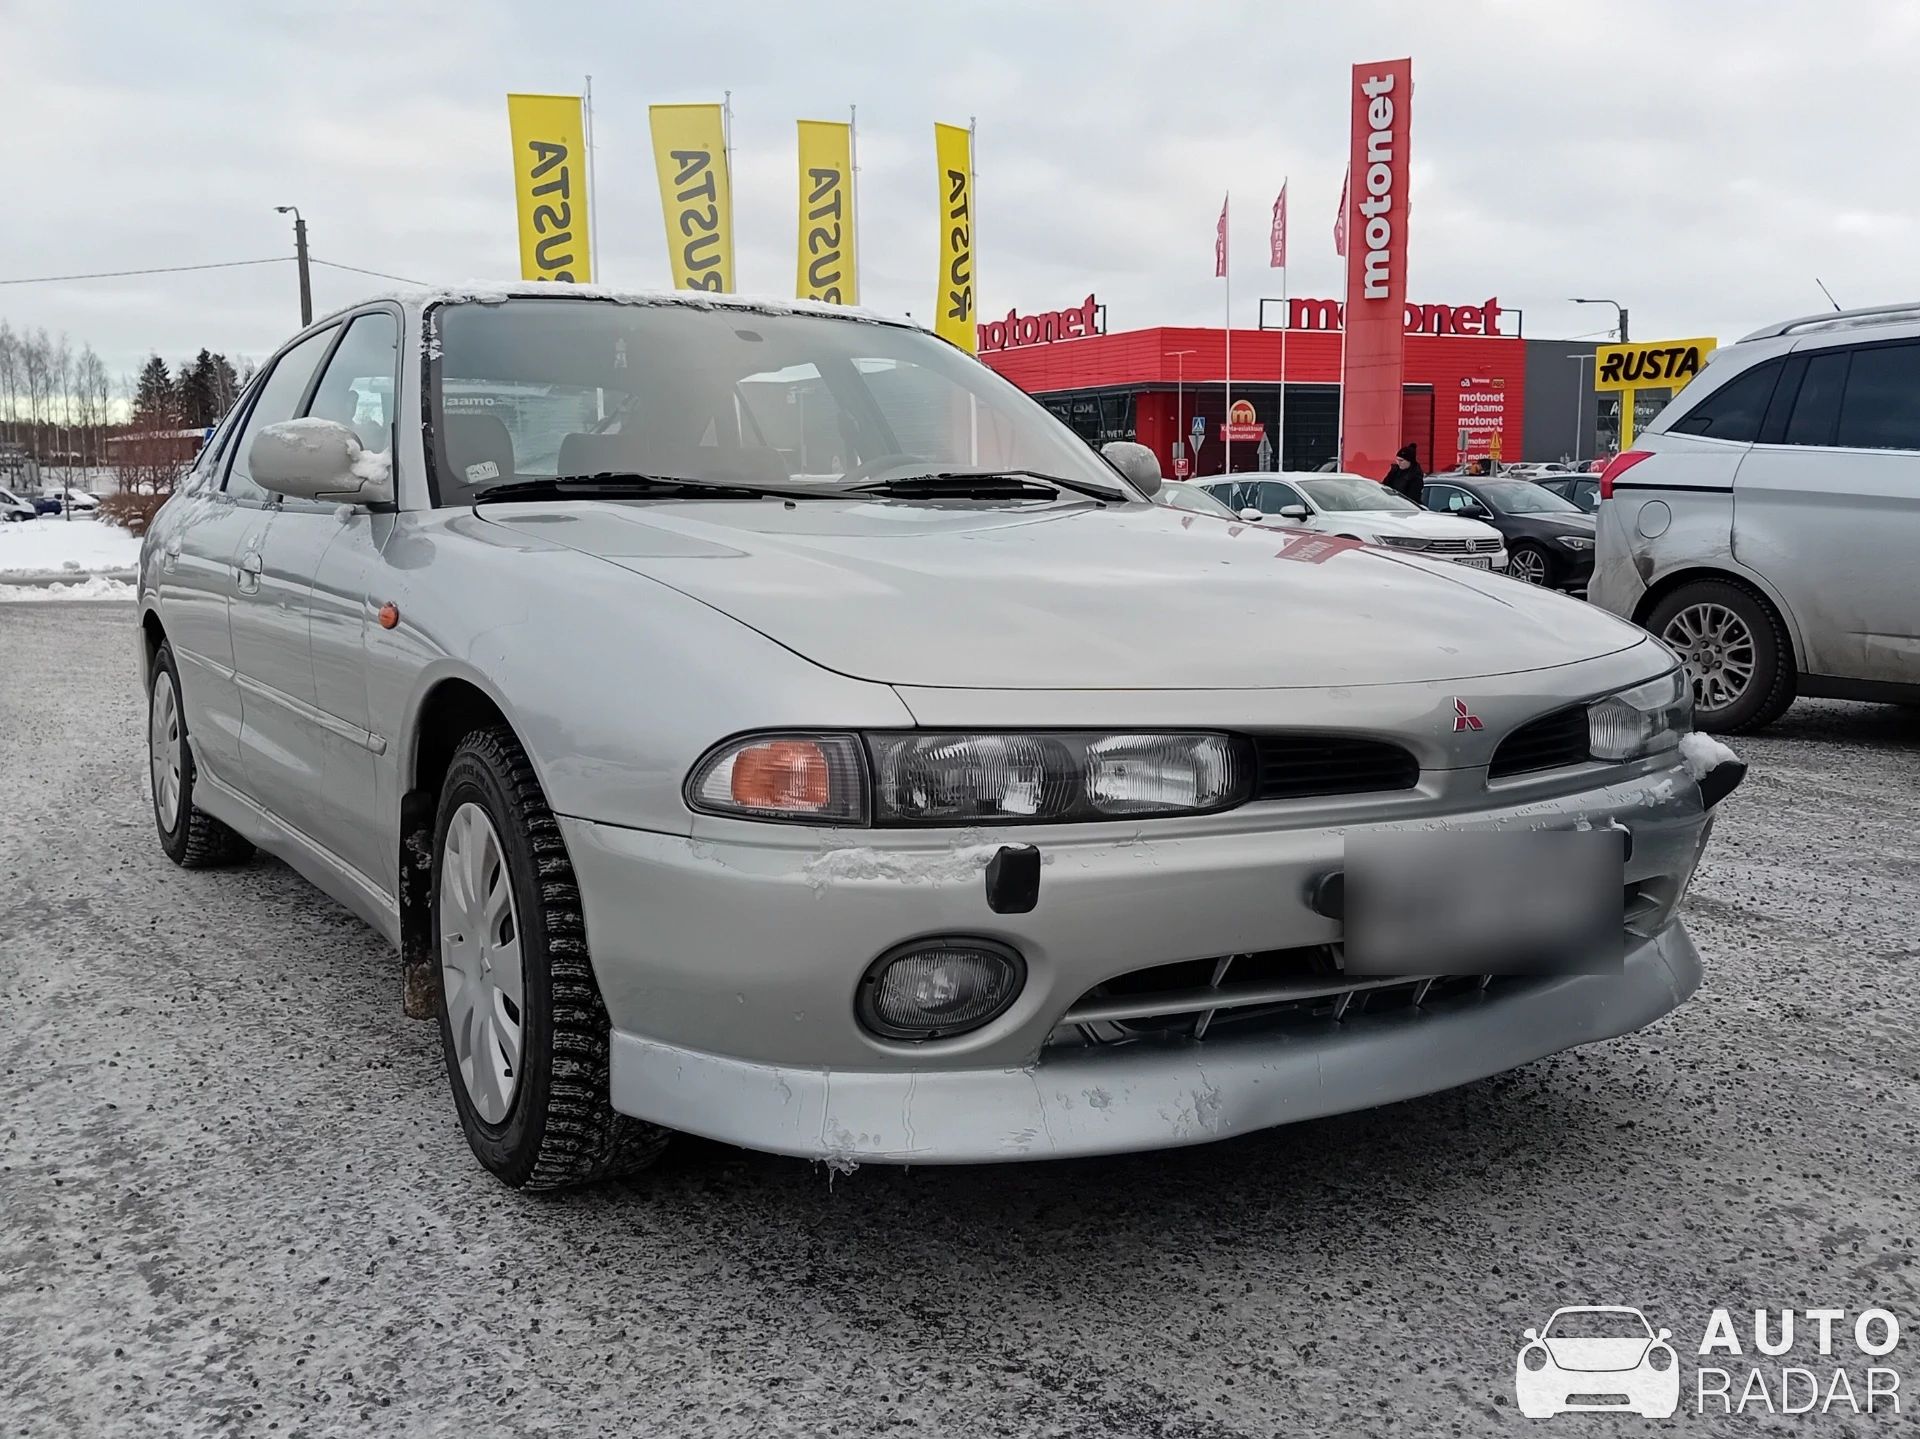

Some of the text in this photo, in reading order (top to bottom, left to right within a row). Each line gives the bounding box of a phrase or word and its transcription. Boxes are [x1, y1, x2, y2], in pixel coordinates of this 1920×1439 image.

[1359, 73, 1395, 299] motonet
[1289, 296, 1501, 336] monet
[1599, 346, 1700, 383] RUSTA
[1459, 392, 1505, 402] motonet
[1459, 403, 1504, 414] korjaamo
[1458, 416, 1503, 426] motonet
